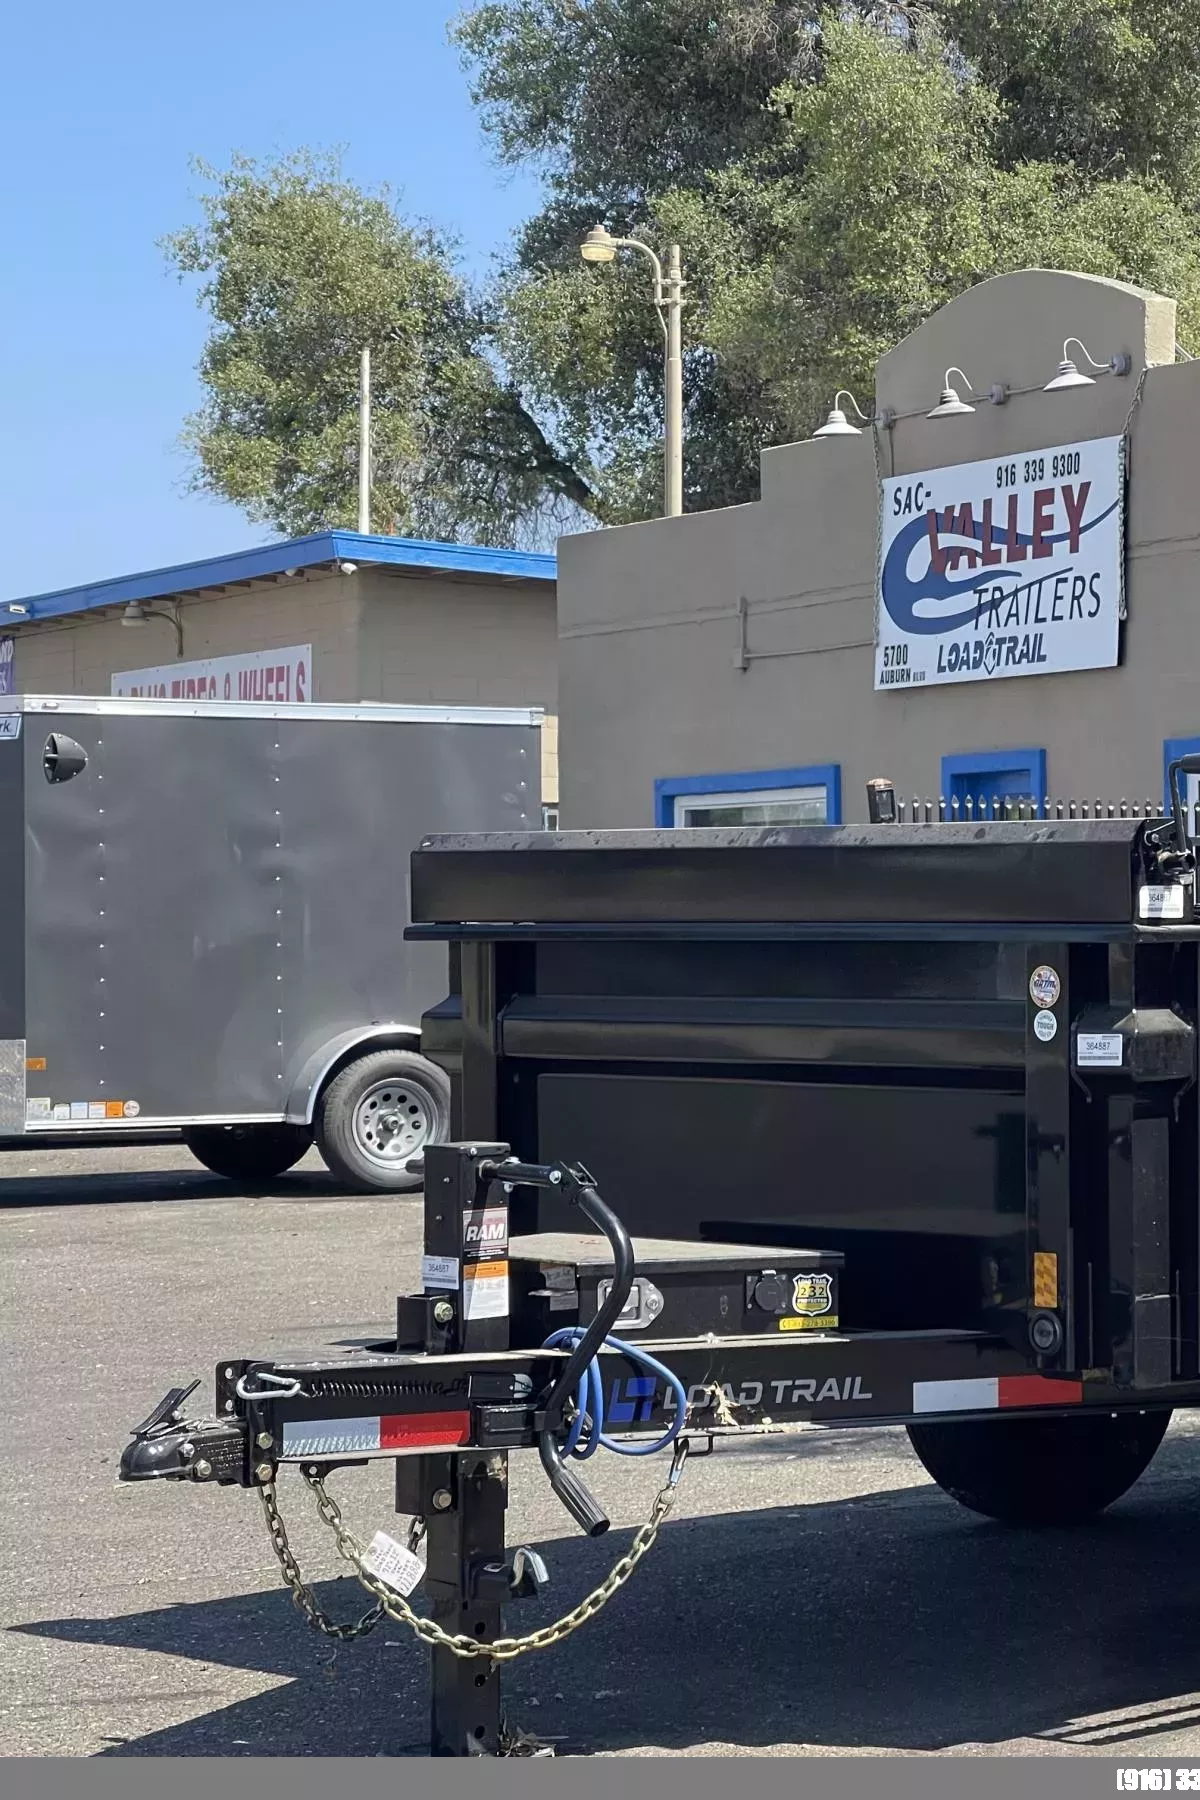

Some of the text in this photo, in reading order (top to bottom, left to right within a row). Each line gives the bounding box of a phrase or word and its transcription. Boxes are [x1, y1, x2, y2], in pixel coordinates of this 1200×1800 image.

[996, 451, 1080, 489] 916 339 9300
[893, 482, 932, 516] SAC-
[926, 481, 1092, 574] VALLEY
[972, 572, 1101, 631] TRAILERS
[883, 643, 908, 667] 5700
[994, 633, 1047, 667] TRAIL
[880, 668, 911, 685] AUBURN
[466, 1223, 505, 1242] RAM
[771, 1376, 873, 1403] TRAIL
